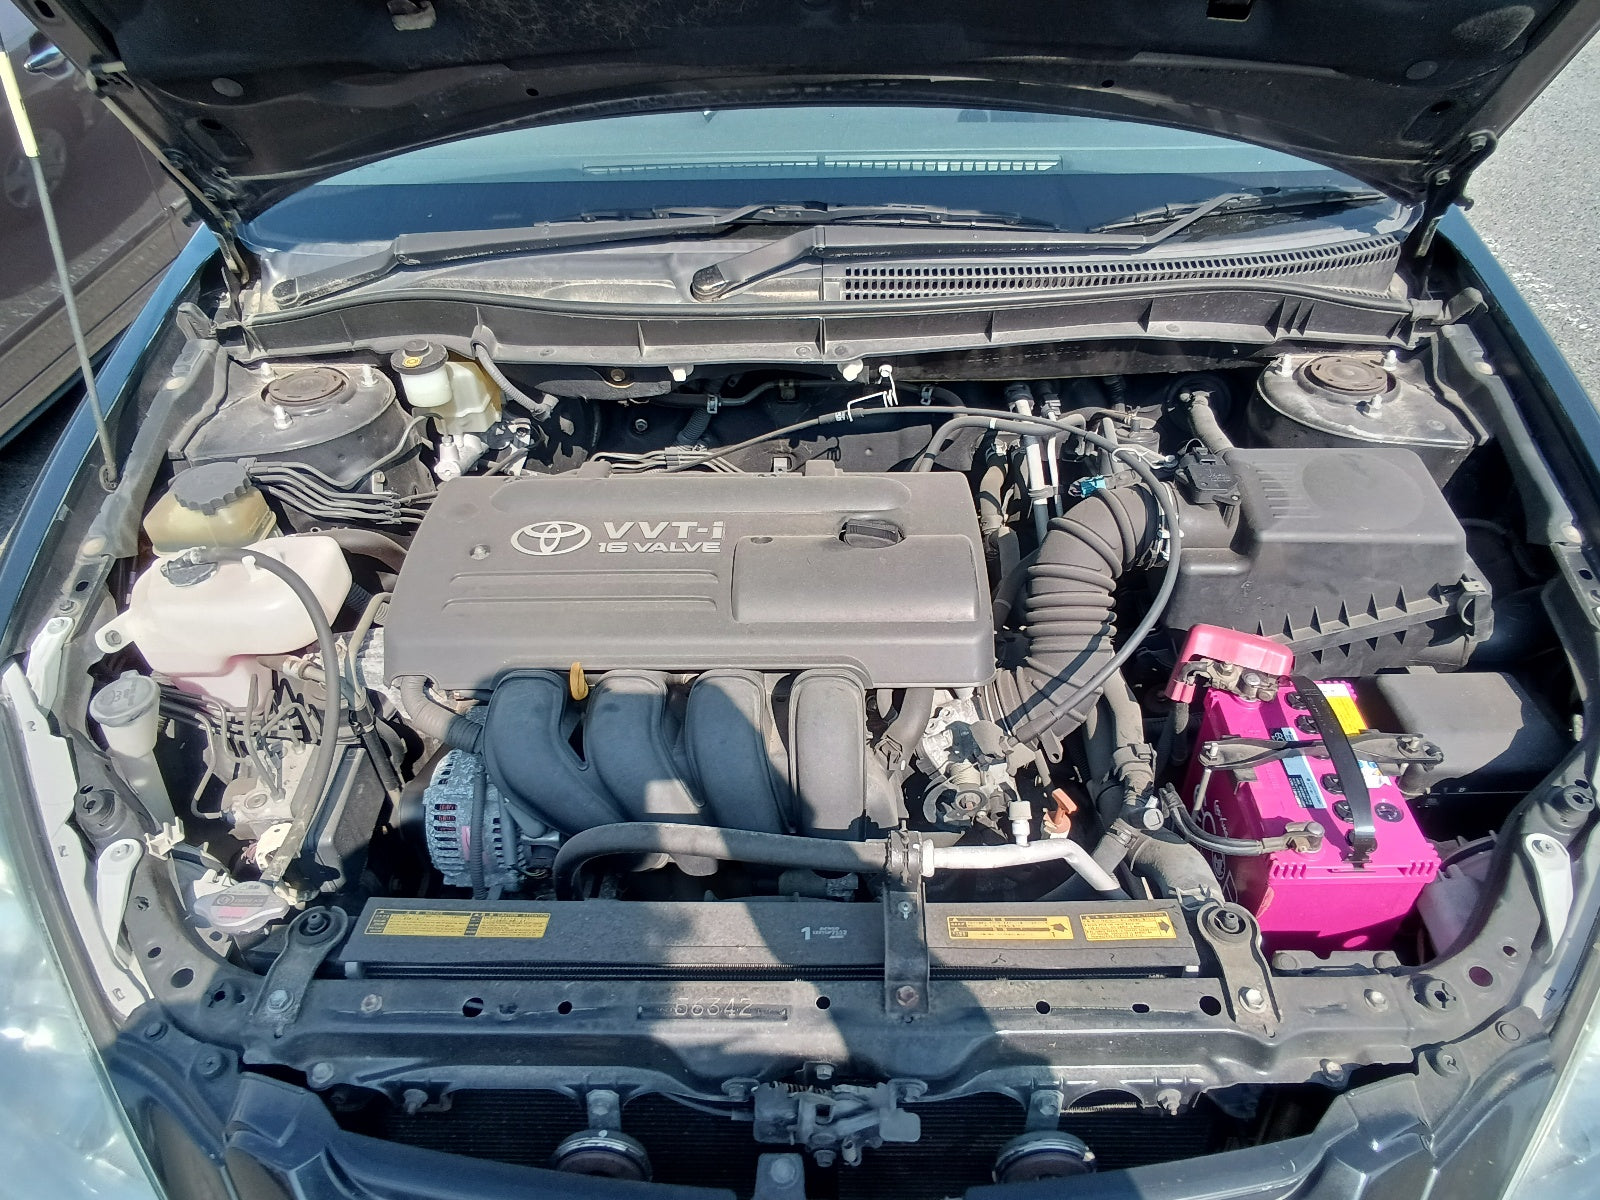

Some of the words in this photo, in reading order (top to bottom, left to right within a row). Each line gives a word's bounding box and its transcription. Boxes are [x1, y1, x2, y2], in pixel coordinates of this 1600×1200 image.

[603, 520, 724, 540] VVT-i
[598, 541, 629, 554] 16
[632, 541, 721, 554] VALVE
[673, 997, 754, 1017] 56342
